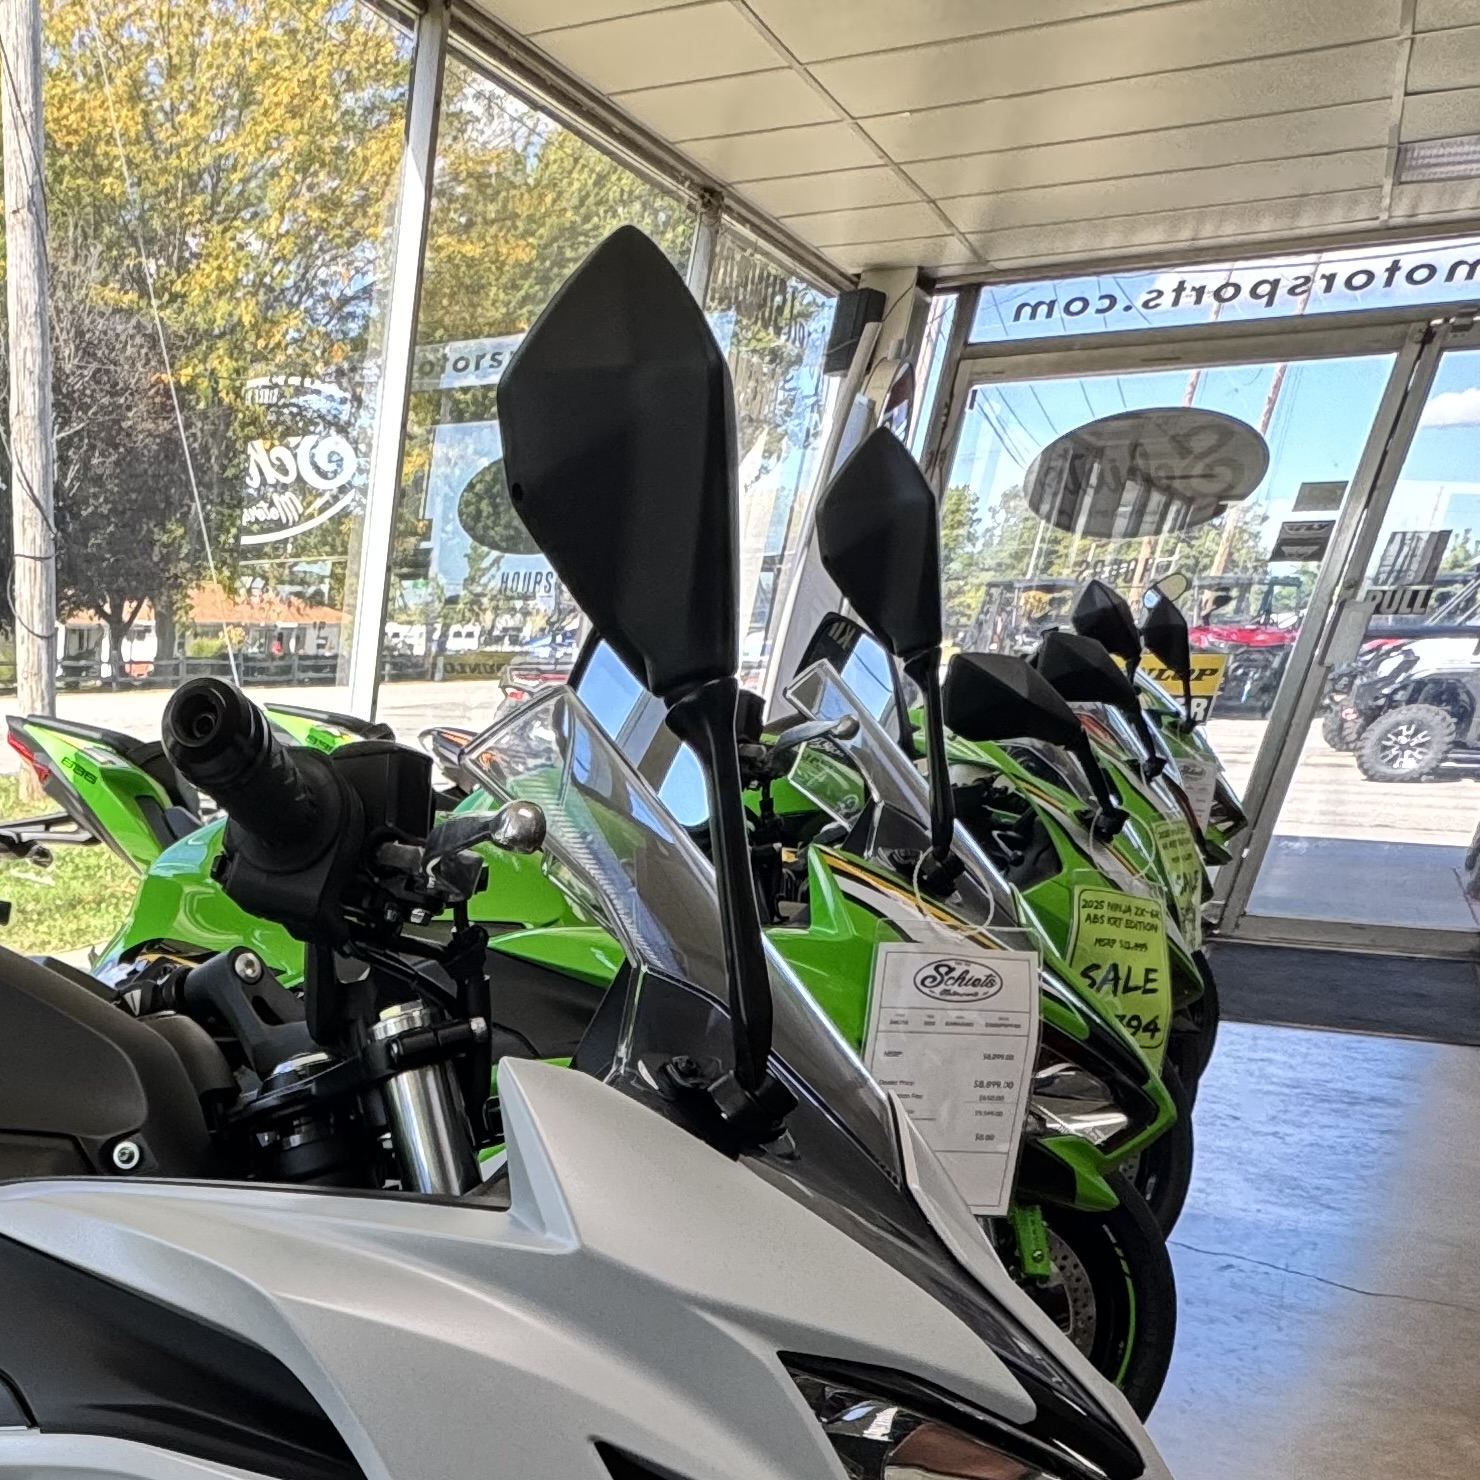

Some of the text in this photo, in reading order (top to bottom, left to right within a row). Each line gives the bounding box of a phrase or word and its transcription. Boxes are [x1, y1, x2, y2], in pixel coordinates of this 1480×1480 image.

[1368, 588, 1428, 615] PULL
[1081, 898, 1105, 910] 2025
[1107, 901, 1133, 917] NINJA
[1084, 912, 1106, 926] ABS
[1124, 918, 1159, 934] EDITION
[1080, 962, 1159, 998] SALE
